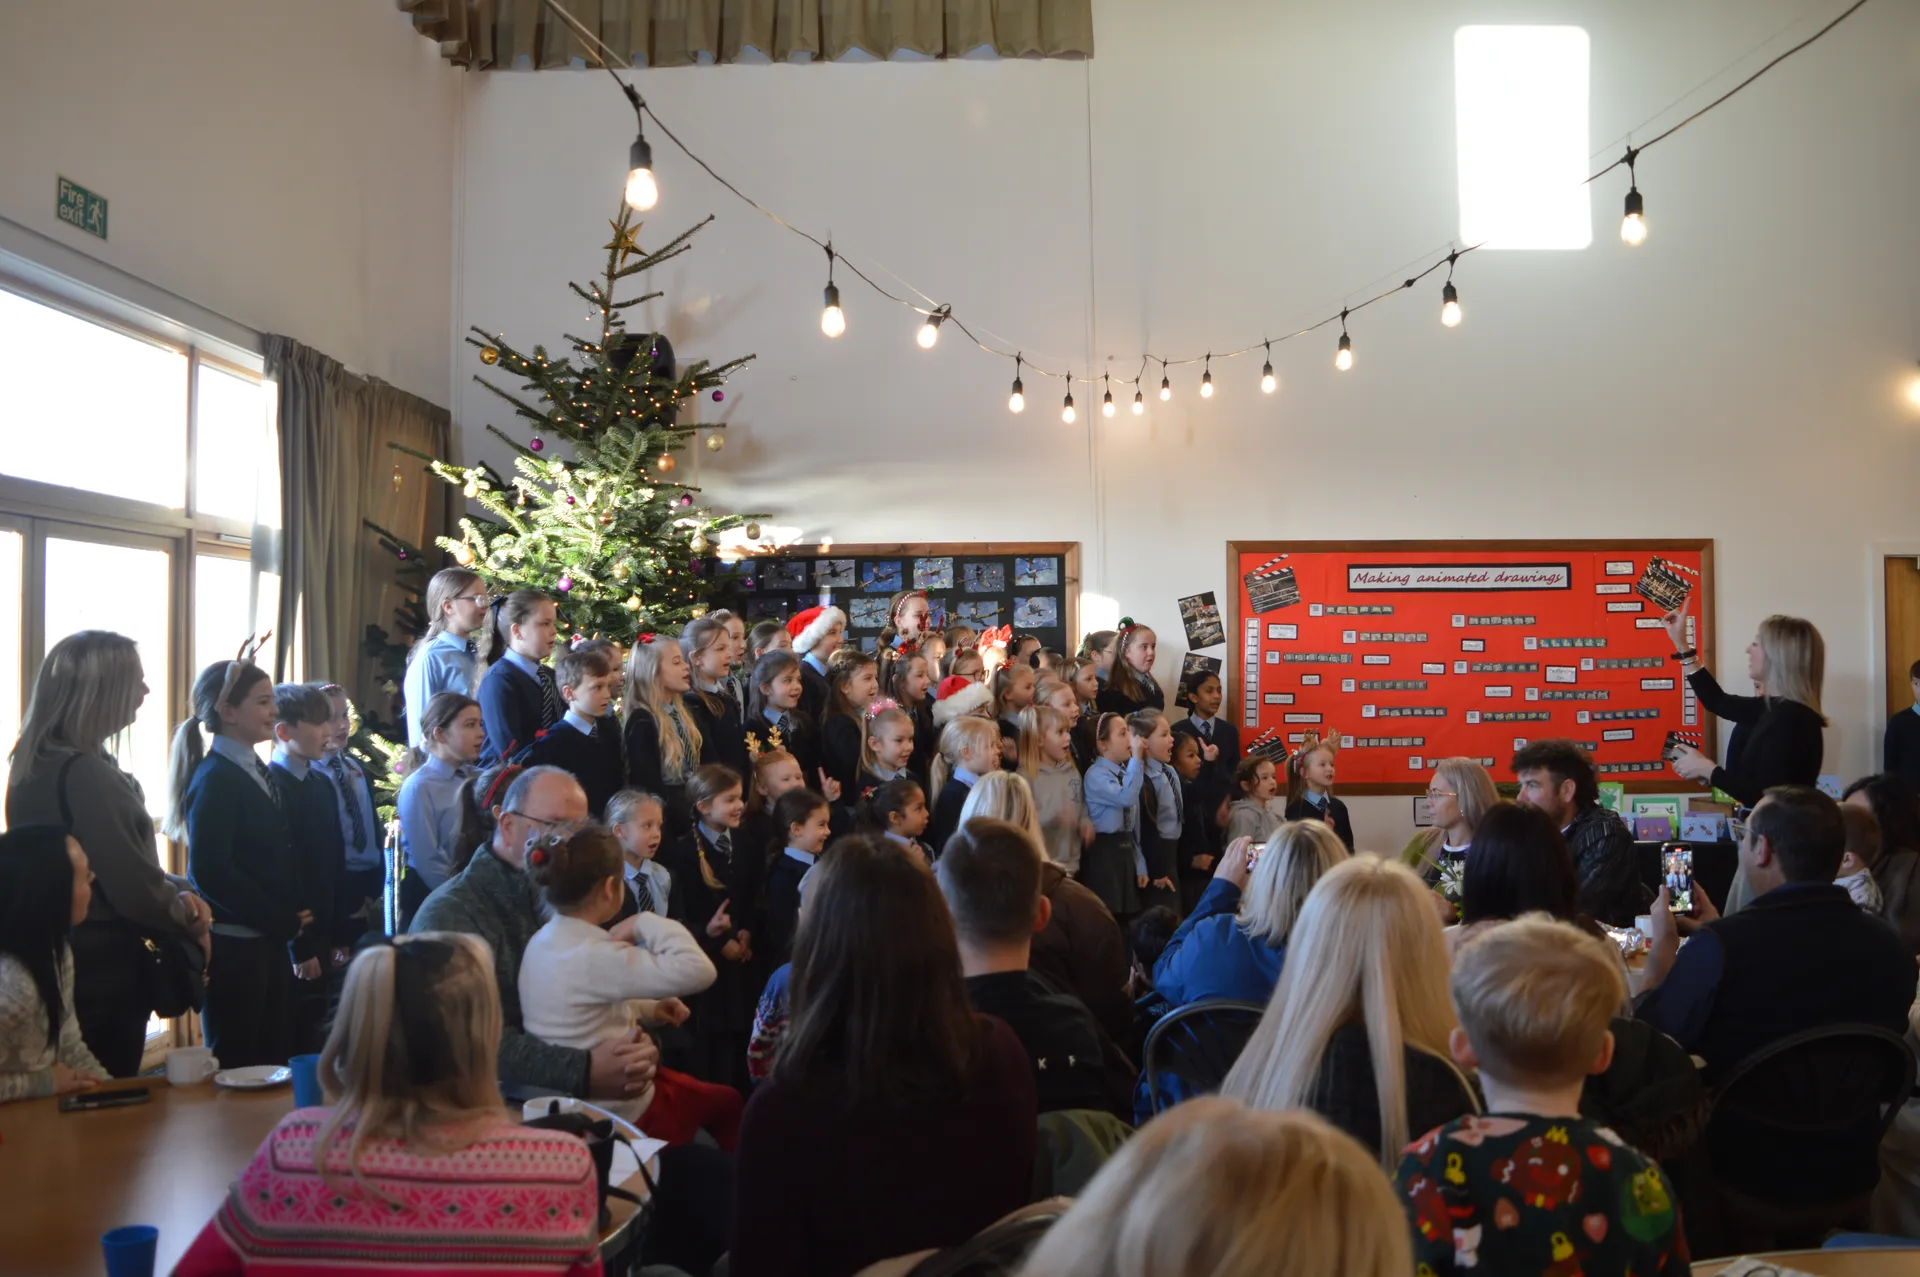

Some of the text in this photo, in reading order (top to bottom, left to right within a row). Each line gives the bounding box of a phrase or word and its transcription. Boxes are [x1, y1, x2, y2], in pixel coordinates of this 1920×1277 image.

[60, 180, 85, 208] Fire
[59, 204, 84, 227] exit
[1353, 571, 1564, 585] Making animated drawings
